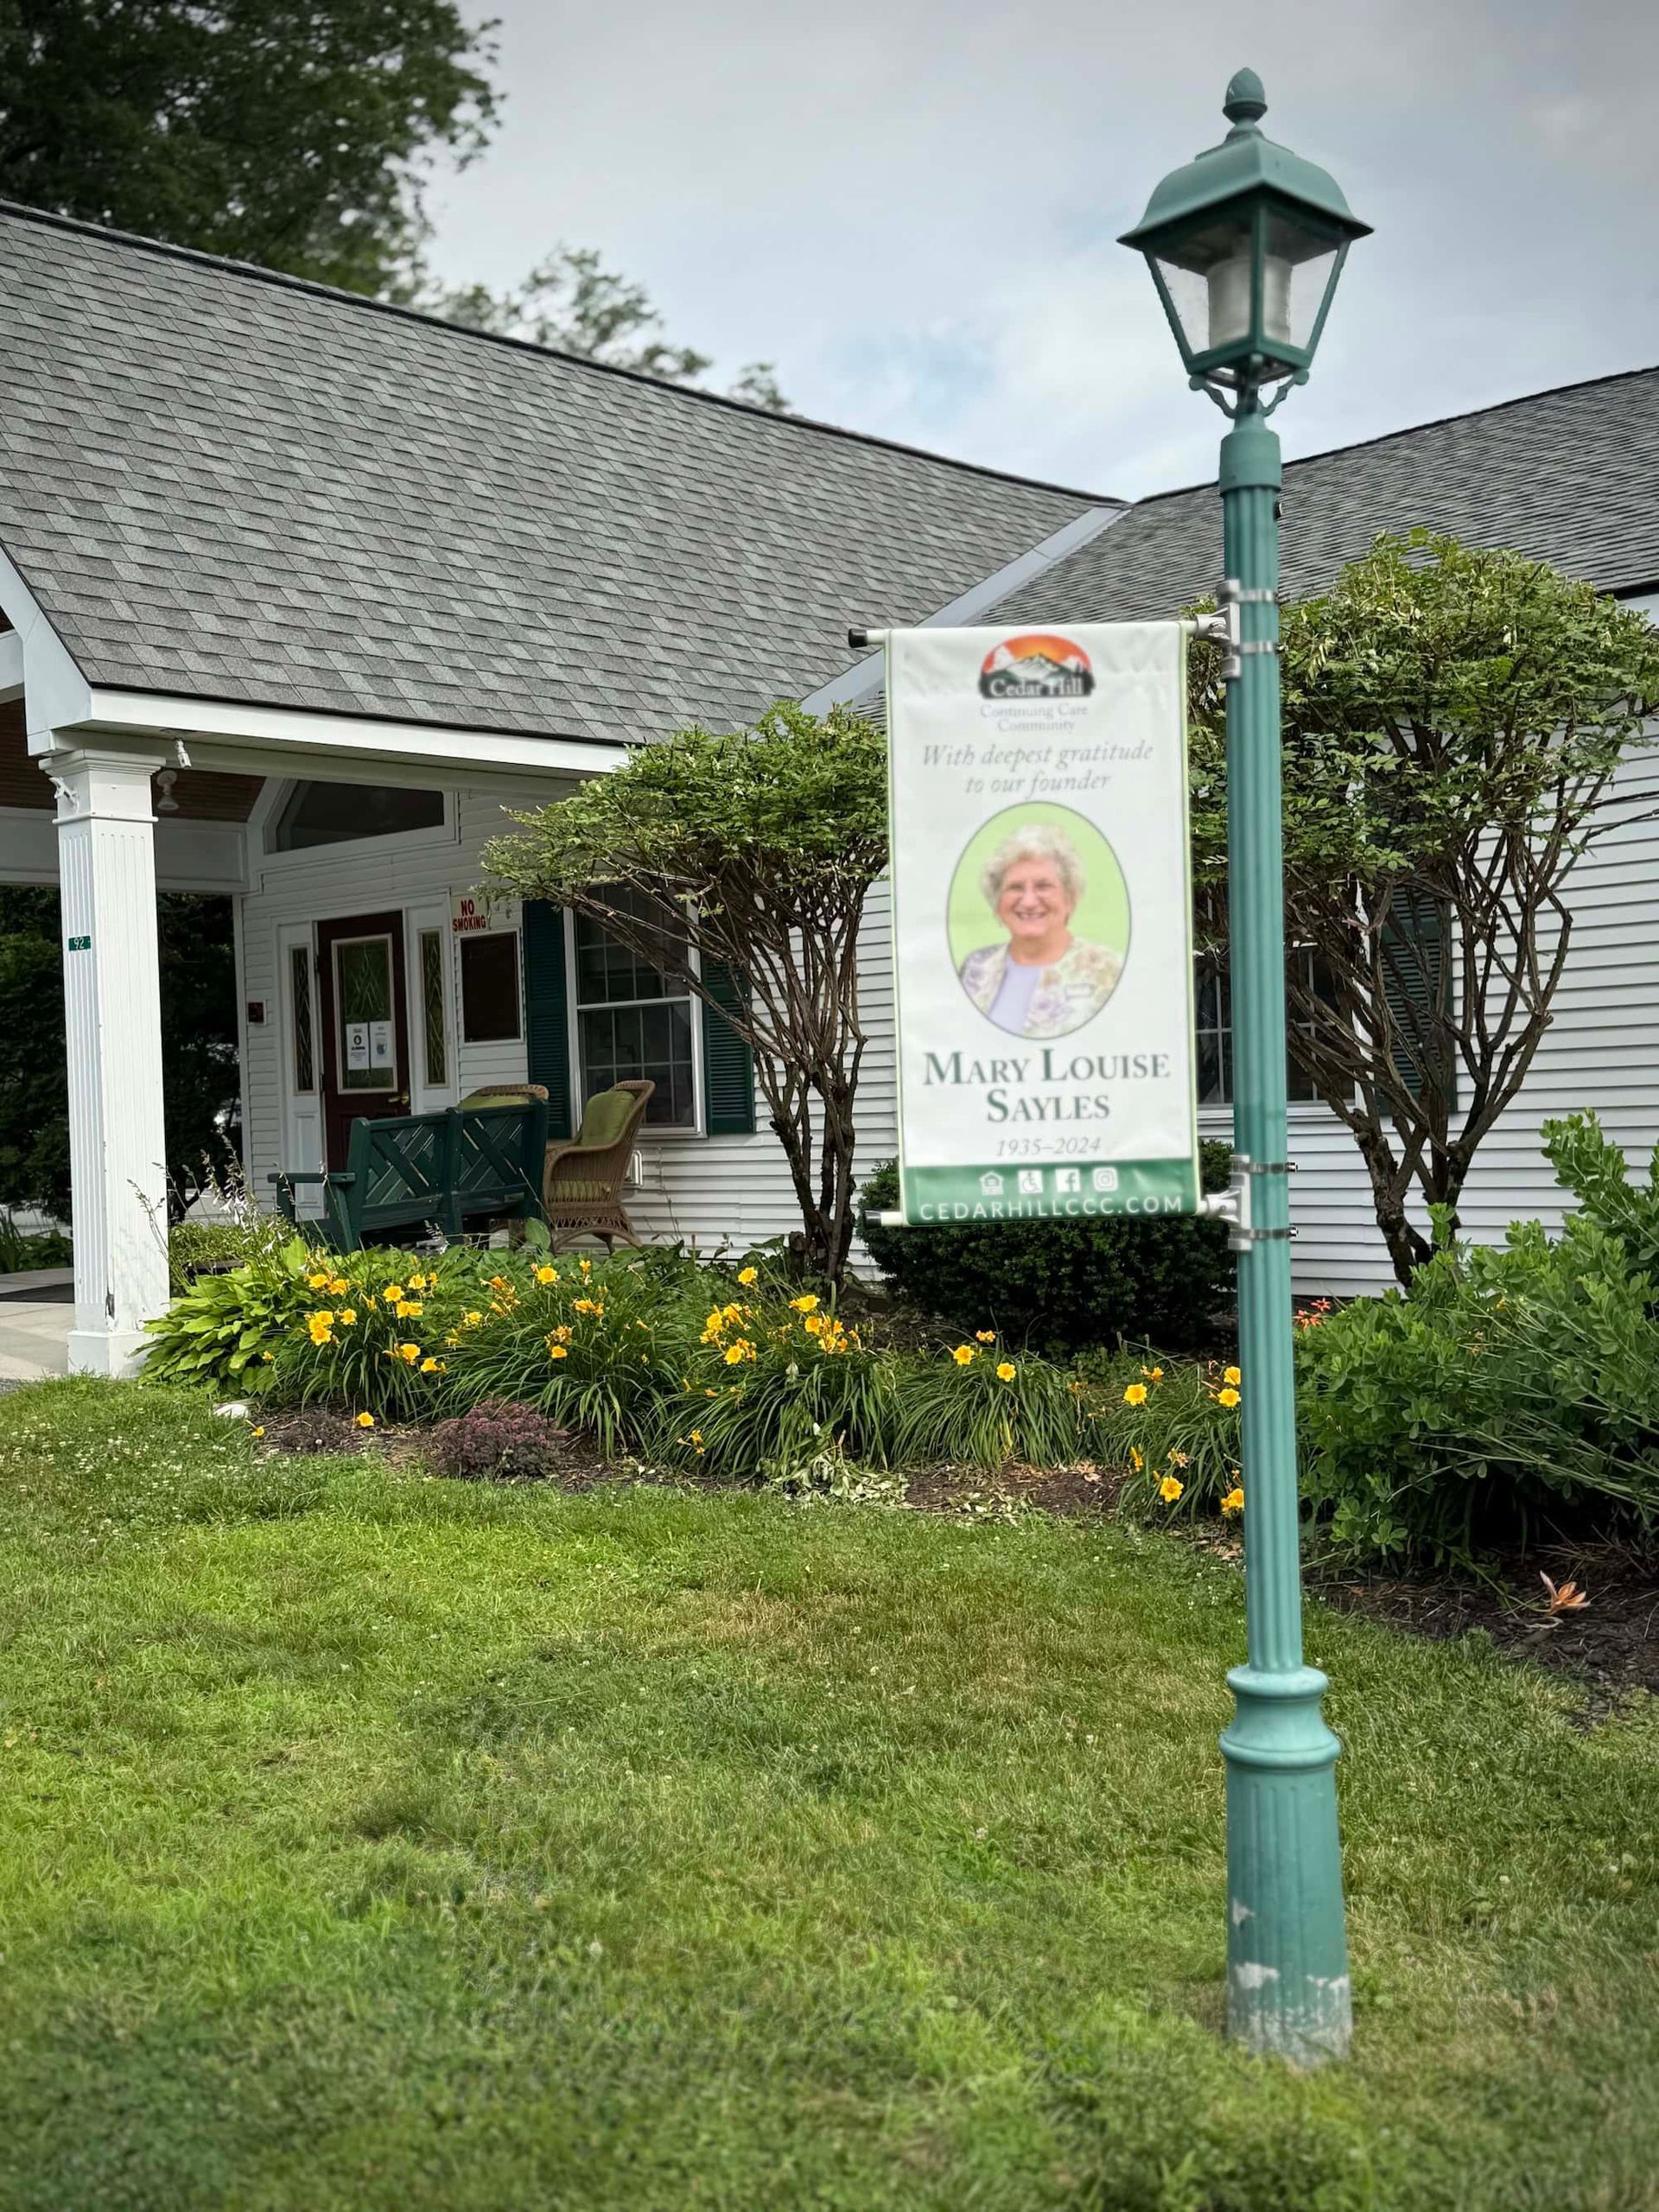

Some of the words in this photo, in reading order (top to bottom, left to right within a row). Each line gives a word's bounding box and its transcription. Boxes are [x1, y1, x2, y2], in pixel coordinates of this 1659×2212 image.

[991, 677, 1040, 696] Cedar
[980, 705, 1053, 719] Continuing
[1058, 703, 1089, 716] Care
[997, 719, 1075, 733] Community
[923, 745, 975, 766] With
[981, 743, 1053, 771] deepest
[1056, 740, 1154, 769] gratitude
[965, 778, 985, 794] to
[992, 779, 1025, 793] our
[1028, 772, 1110, 798] founder
[461, 899, 474, 917] NO
[453, 915, 486, 932] SMOKING
[74, 937, 85, 950] 92
[924, 1052, 1030, 1085] MARY
[1041, 1048, 1171, 1081] LOUISE
[987, 1089, 1110, 1122] SAYLES
[920, 1196, 1182, 1220] CEDARHILLCCC.COM
